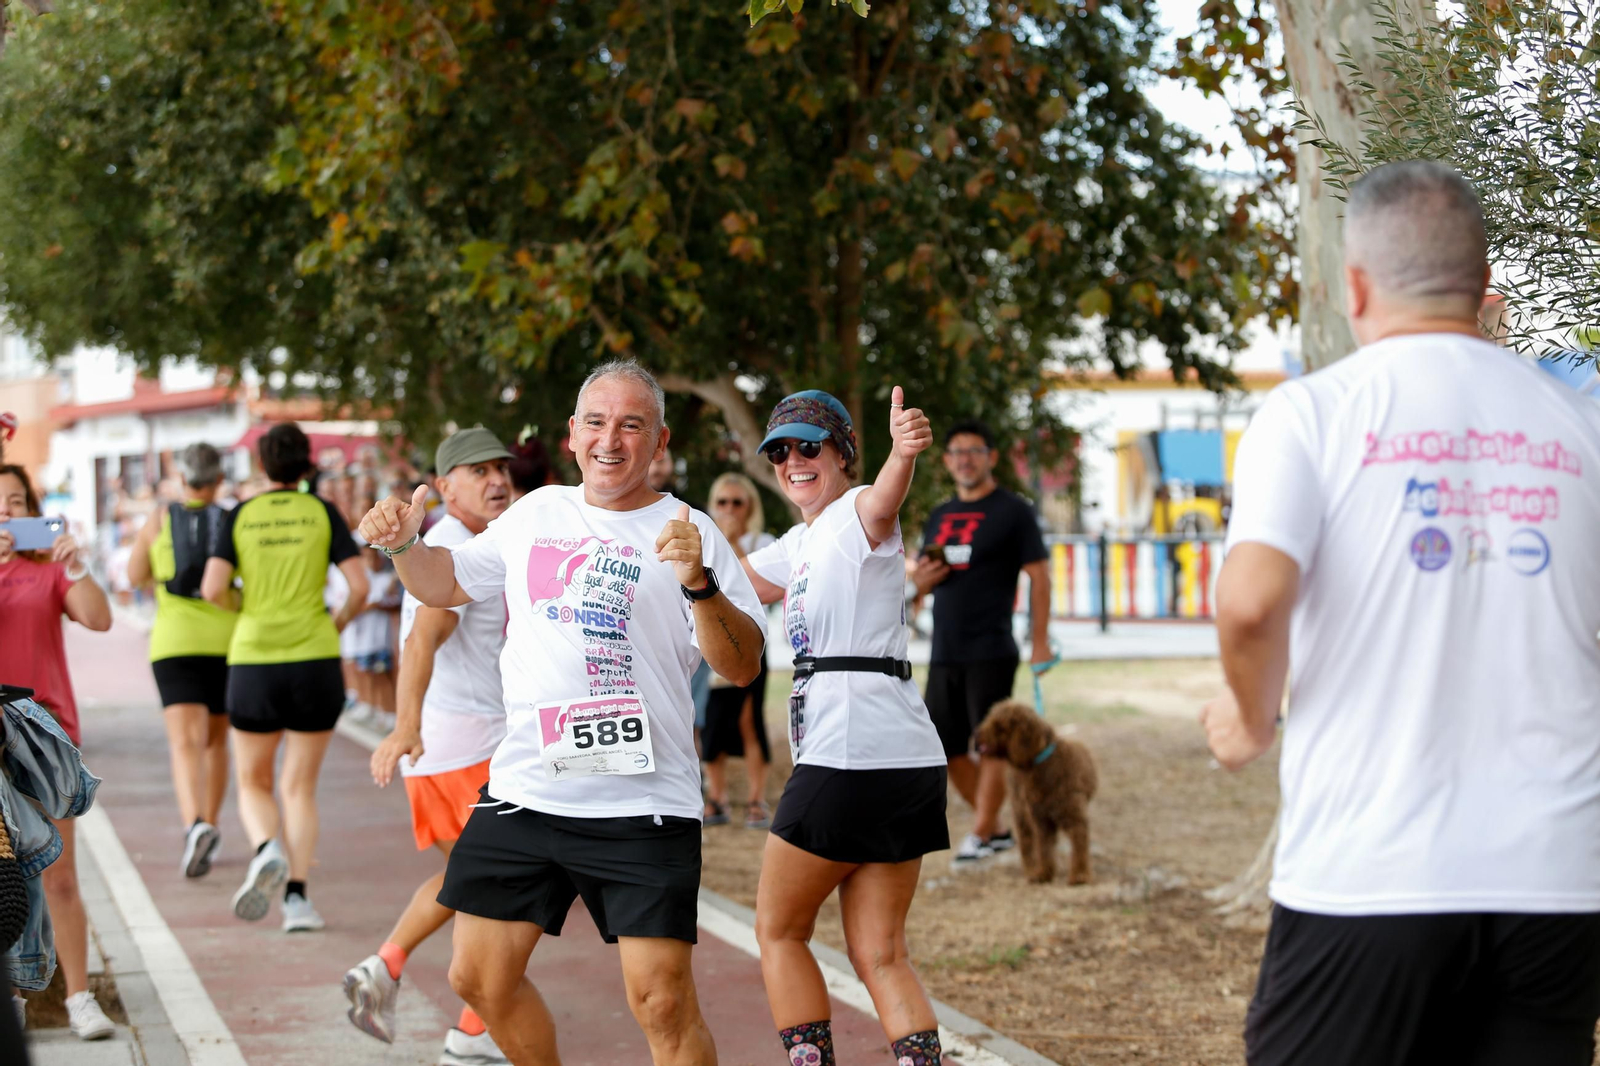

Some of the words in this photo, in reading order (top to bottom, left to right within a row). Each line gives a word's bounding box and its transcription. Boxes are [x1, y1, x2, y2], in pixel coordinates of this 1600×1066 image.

[594, 545, 643, 560] AMOR
[581, 600, 632, 621] HUMILDAD
[582, 586, 632, 611] FUERZA
[546, 605, 628, 634] SONRISA
[573, 717, 644, 749] 589
